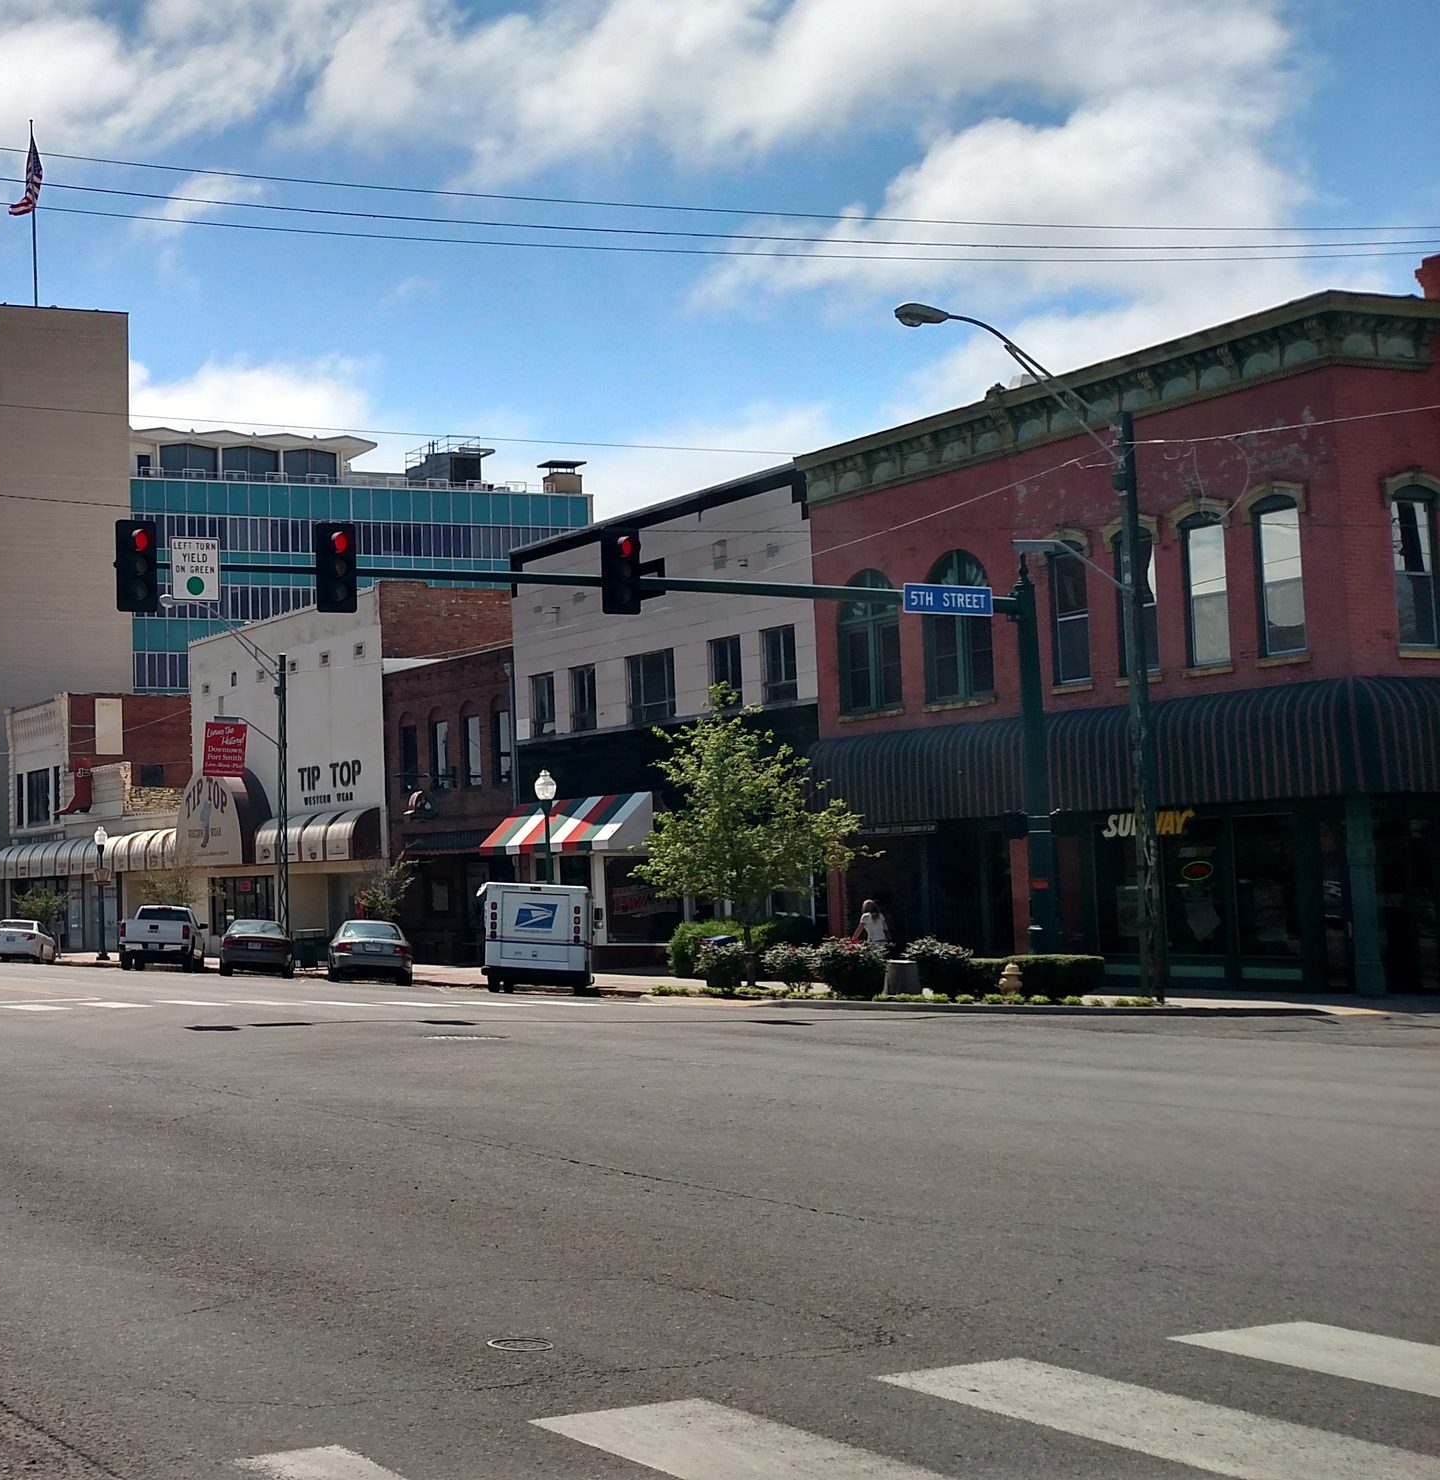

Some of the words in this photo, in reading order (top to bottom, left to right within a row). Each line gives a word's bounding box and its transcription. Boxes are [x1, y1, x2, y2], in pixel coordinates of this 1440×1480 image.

[173, 541, 191, 550] LEFT
[196, 542, 216, 551] TURN
[182, 553, 208, 563] YIELD
[175, 565, 186, 573] ON
[190, 565, 215, 574] GREEN
[910, 591, 934, 606] 5TH
[942, 593, 986, 609] STREET
[297, 765, 321, 792] TIP
[329, 760, 362, 788] TOP
[185, 778, 203, 819] TIP
[206, 776, 228, 814] TOP
[304, 794, 331, 806] WESTERN
[336, 791, 354, 802] WEAR
[1102, 808, 1196, 838] SUWAY
